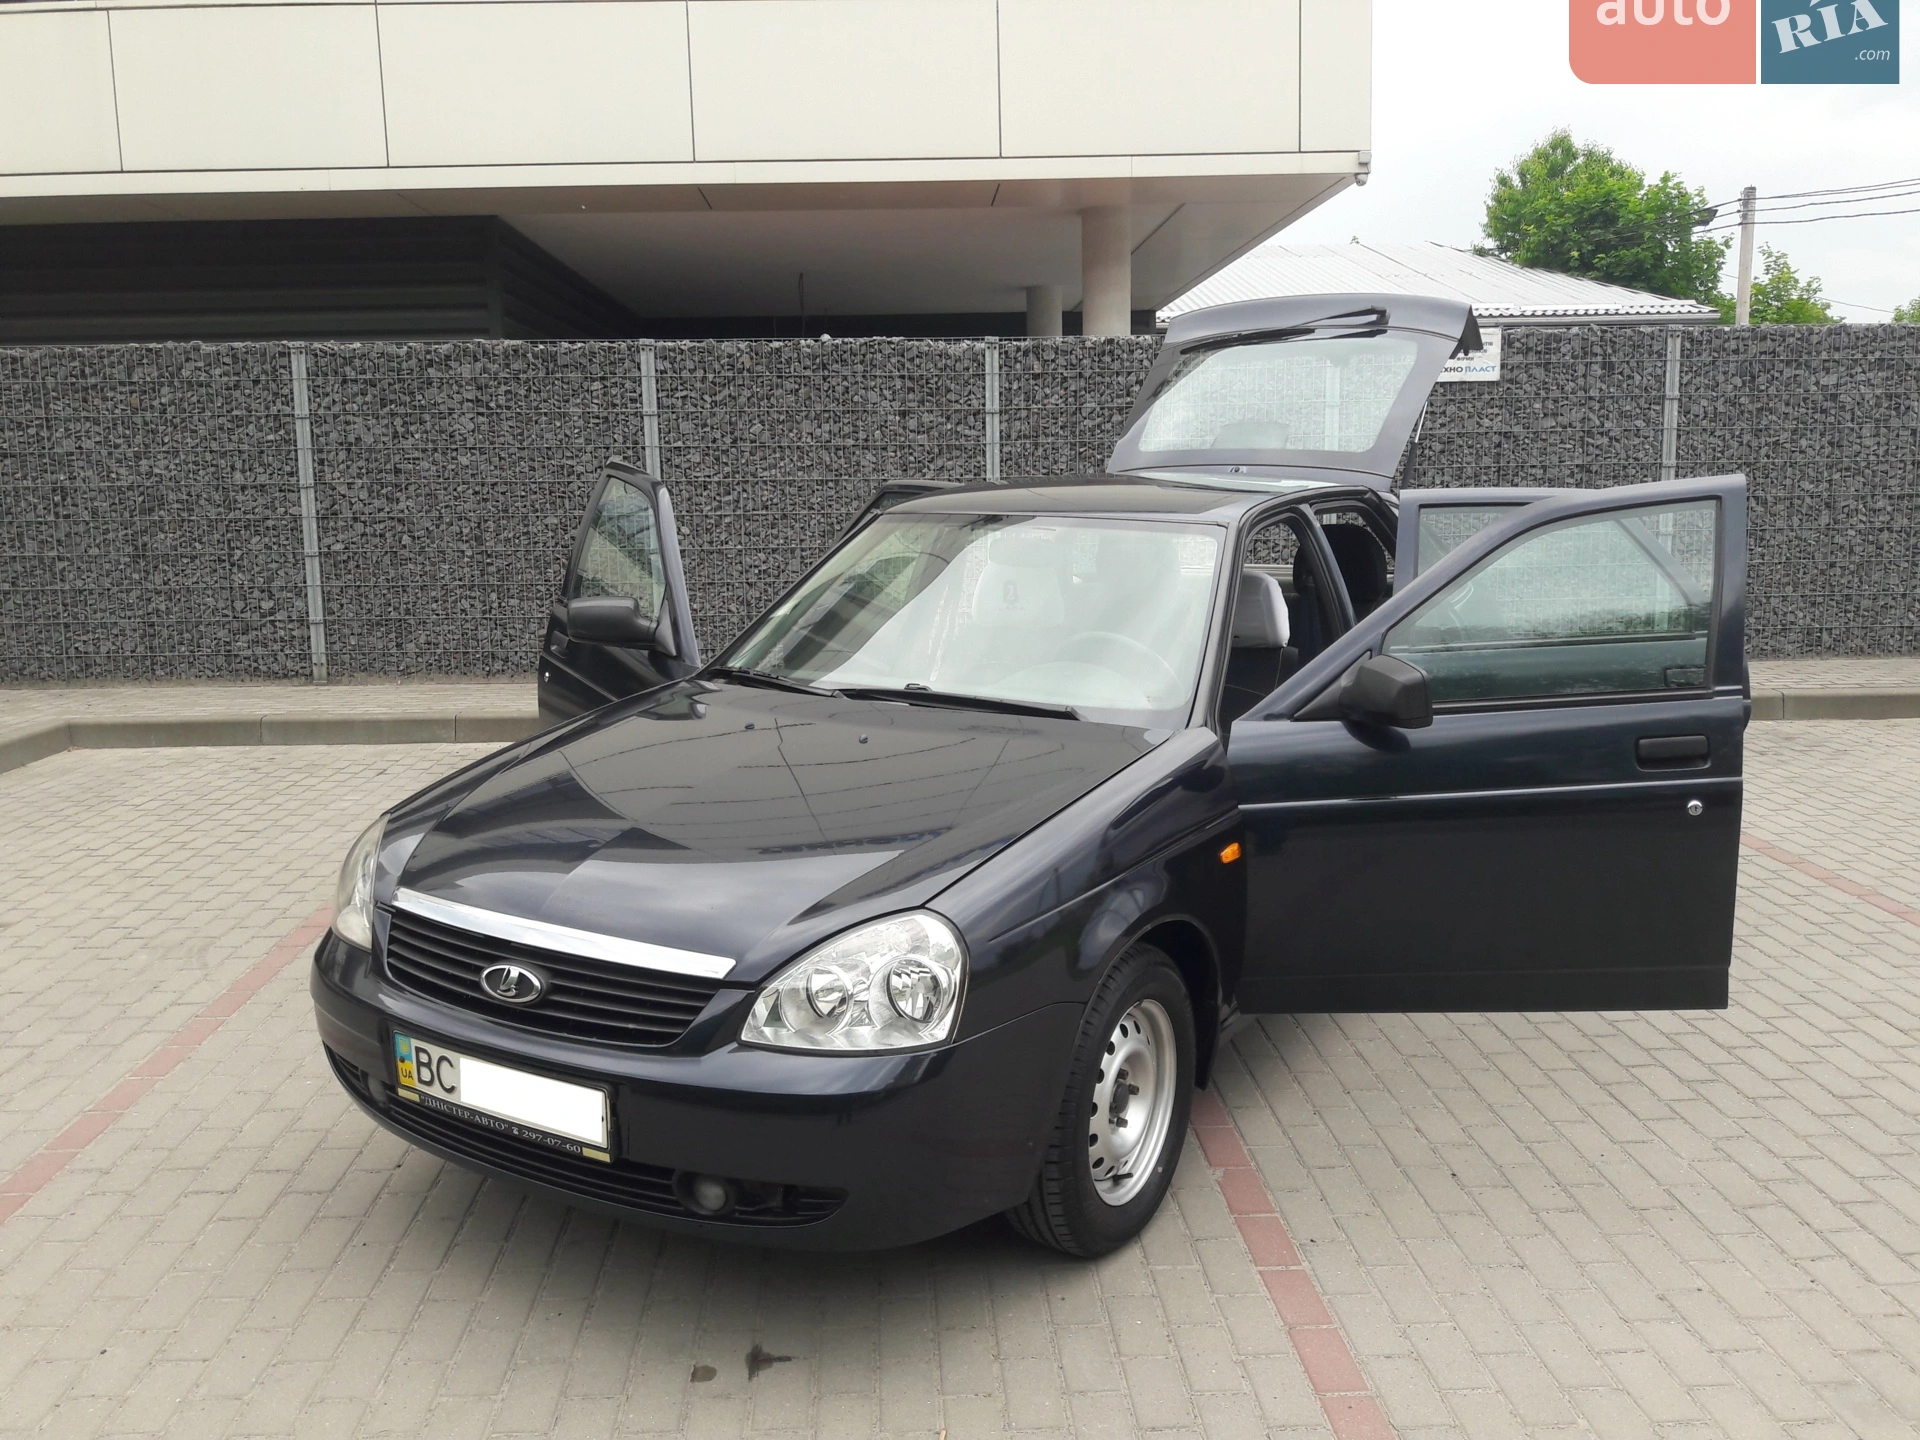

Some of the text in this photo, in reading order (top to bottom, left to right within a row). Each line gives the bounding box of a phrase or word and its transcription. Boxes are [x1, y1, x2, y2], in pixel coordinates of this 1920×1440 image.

[400, 1066, 414, 1081] UA
[414, 1045, 457, 1095] BC
[521, 1129, 582, 1154] 297-07-60
